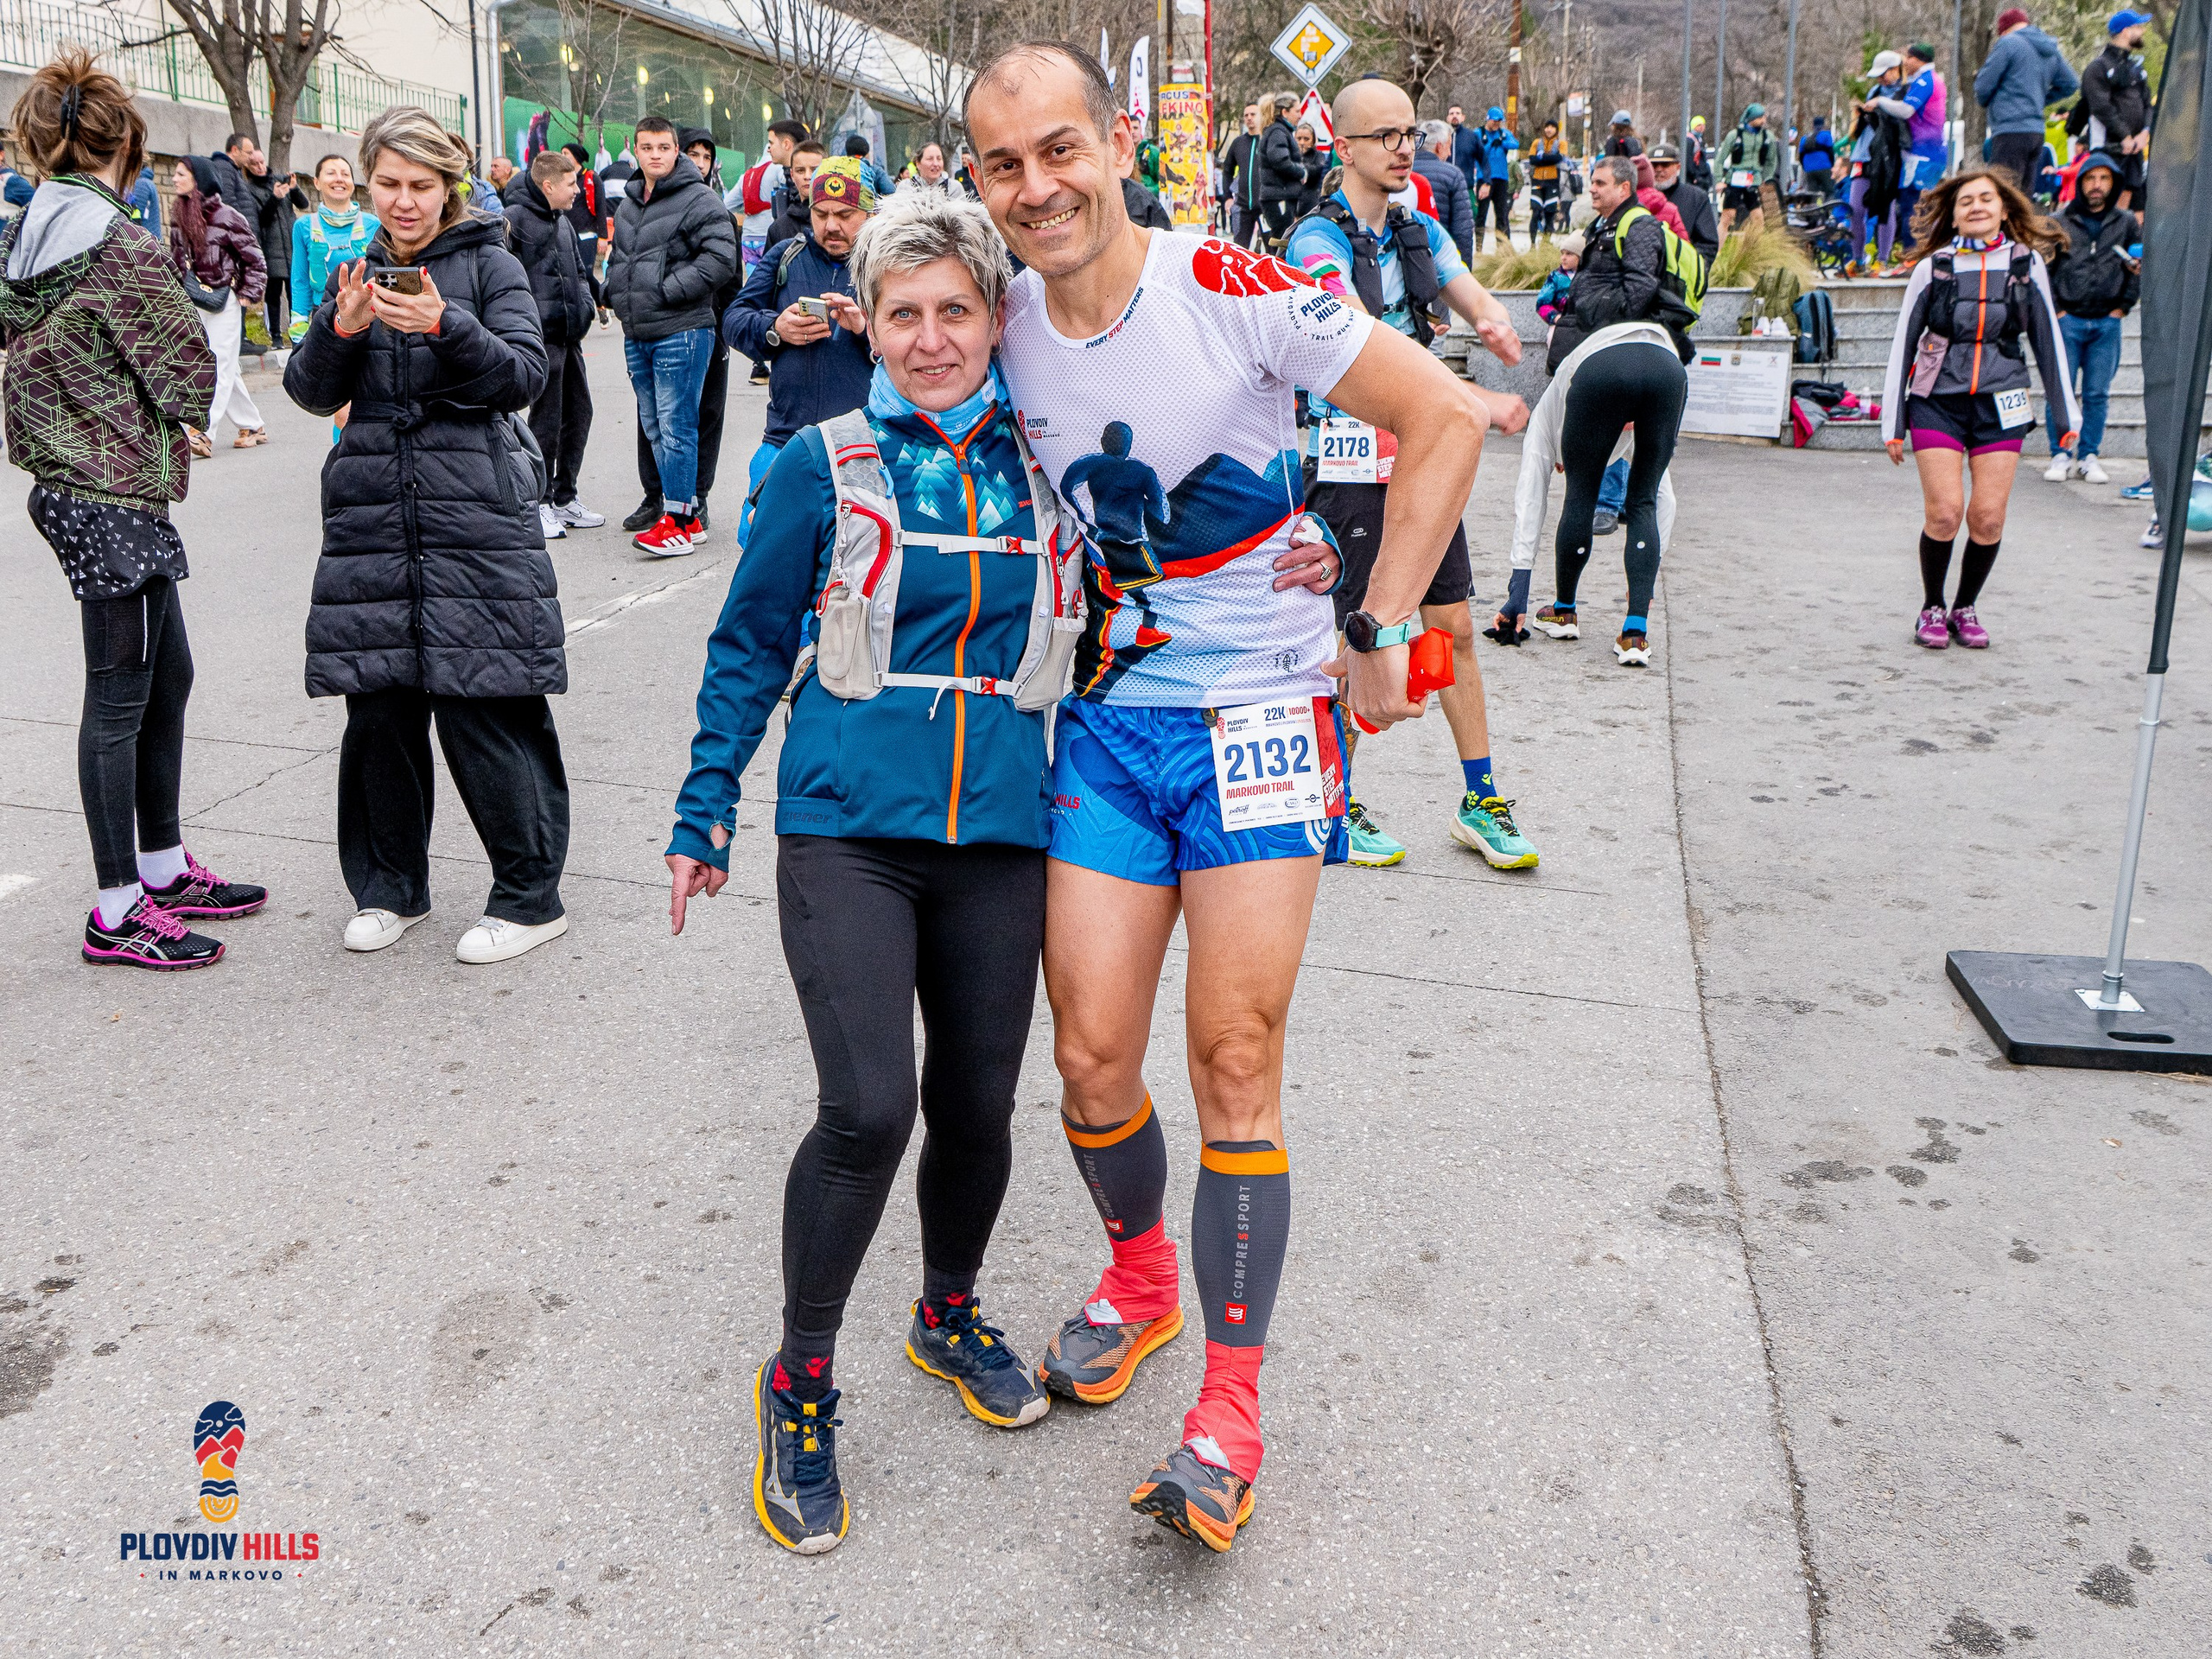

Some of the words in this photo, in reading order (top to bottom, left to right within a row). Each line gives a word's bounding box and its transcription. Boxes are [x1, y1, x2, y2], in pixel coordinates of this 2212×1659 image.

[1300, 292, 1335, 316] PLOVD
[1314, 302, 1342, 323] HILLS
[1085, 334, 1108, 349] EVERY
[1109, 320, 1124, 339] STEP
[1123, 286, 1144, 324] MATTERS
[1337, 323, 1350, 336] RUN
[1027, 417, 1048, 429] PLOVDIV
[1324, 436, 1370, 458] 2178
[1227, 718, 1249, 727] PLOVDIV
[1264, 706, 1286, 721] 22K
[1288, 705, 1310, 715] 10000+
[1224, 734, 1312, 783] 2132
[1226, 783, 1270, 799] MARKOVO
[1271, 780, 1295, 793] TRAIL
[1233, 1185, 1250, 1299] COMPRESSPORT
